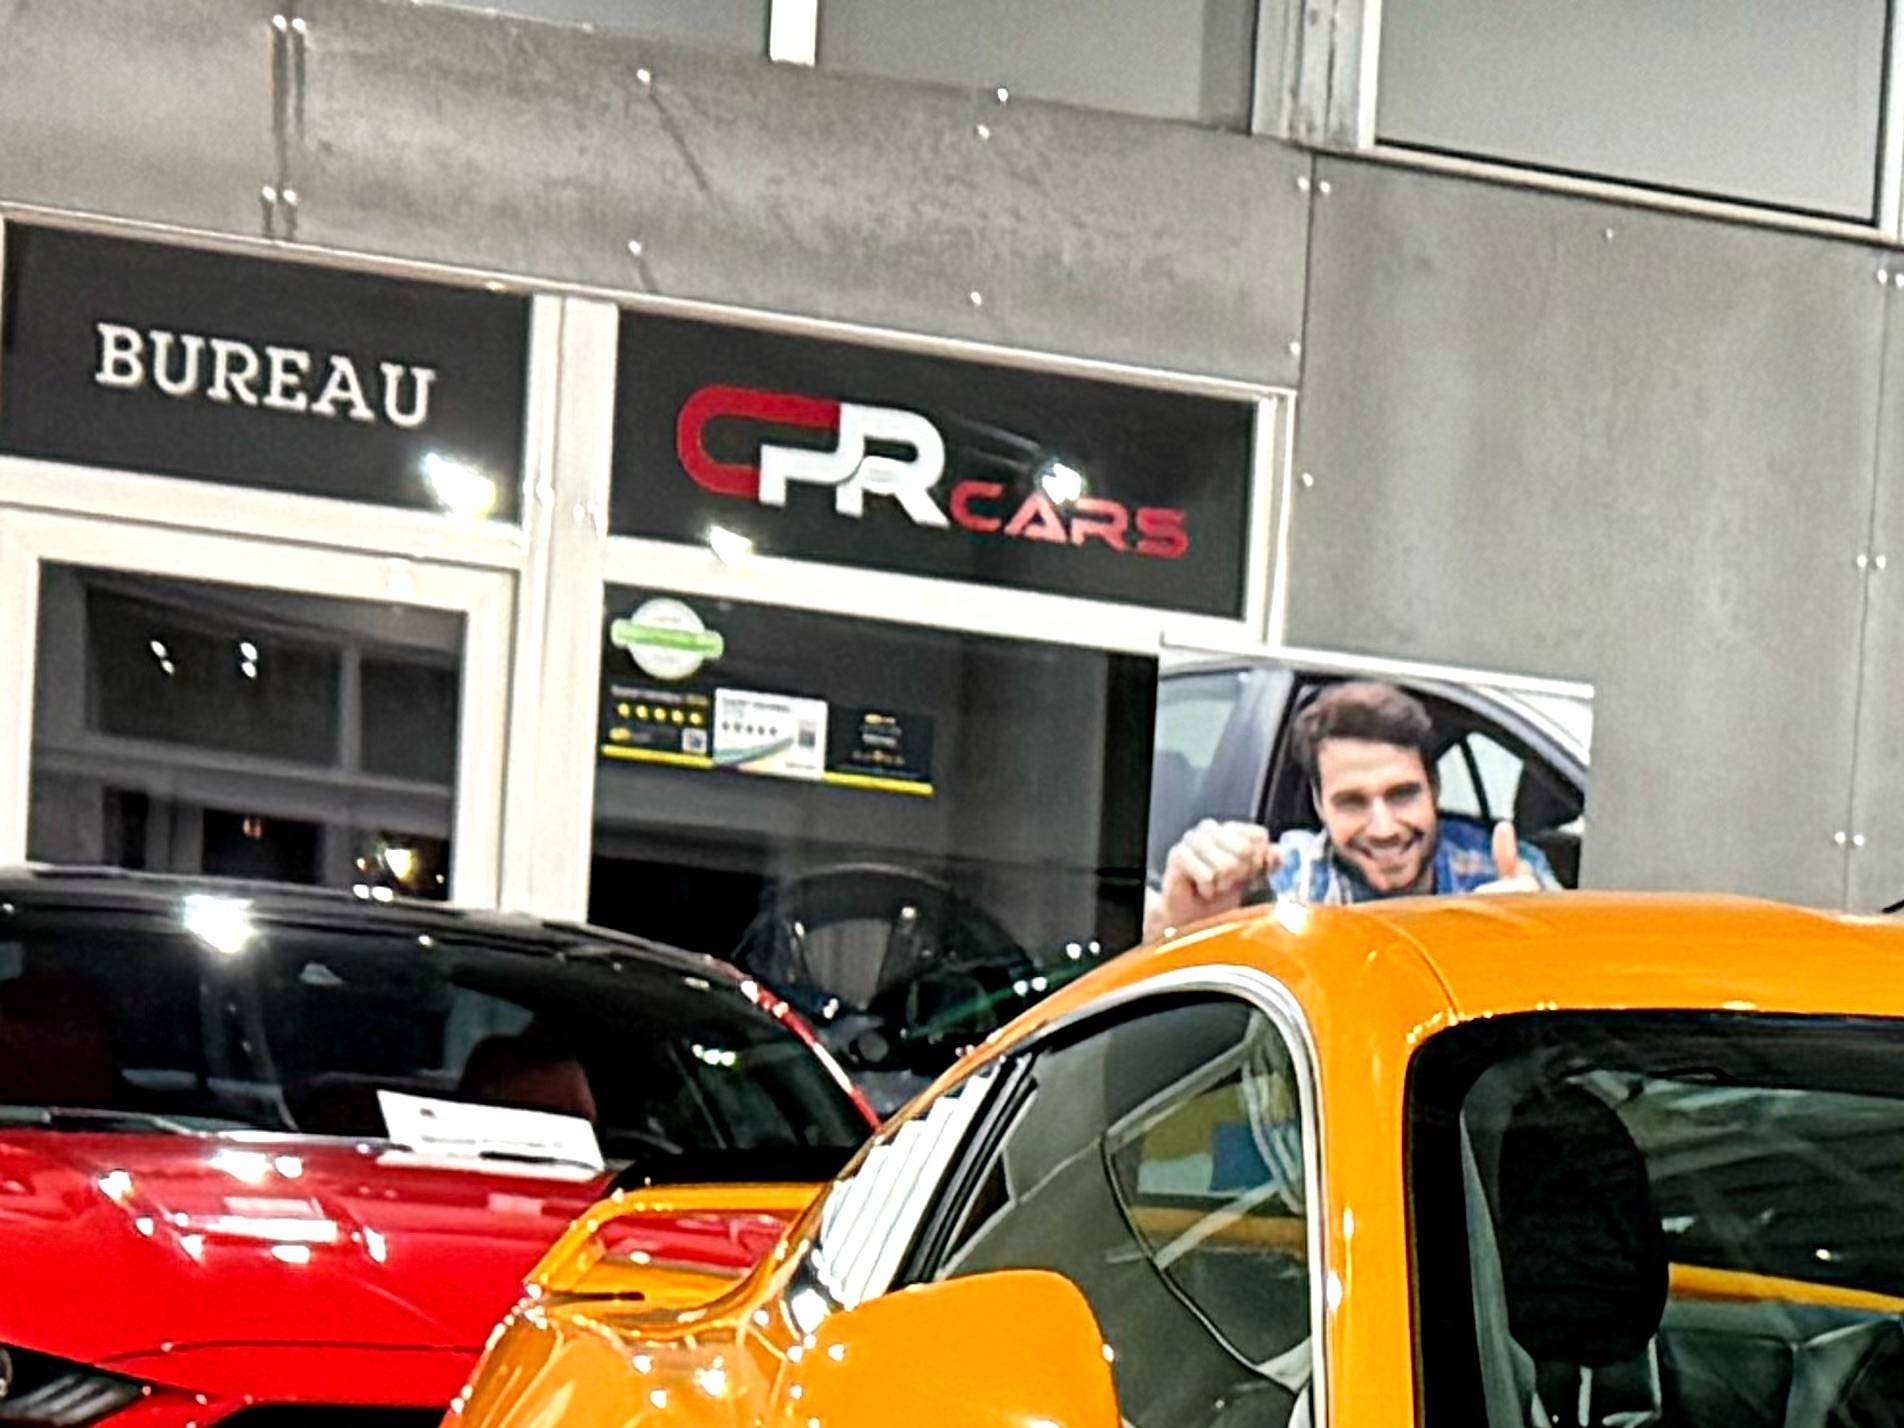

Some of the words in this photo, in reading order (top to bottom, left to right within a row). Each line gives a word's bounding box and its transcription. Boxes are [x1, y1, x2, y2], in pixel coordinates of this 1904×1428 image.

[95, 322, 436, 428] BUREAU
[676, 384, 950, 528] CPR
[948, 481, 1189, 559] CARS
